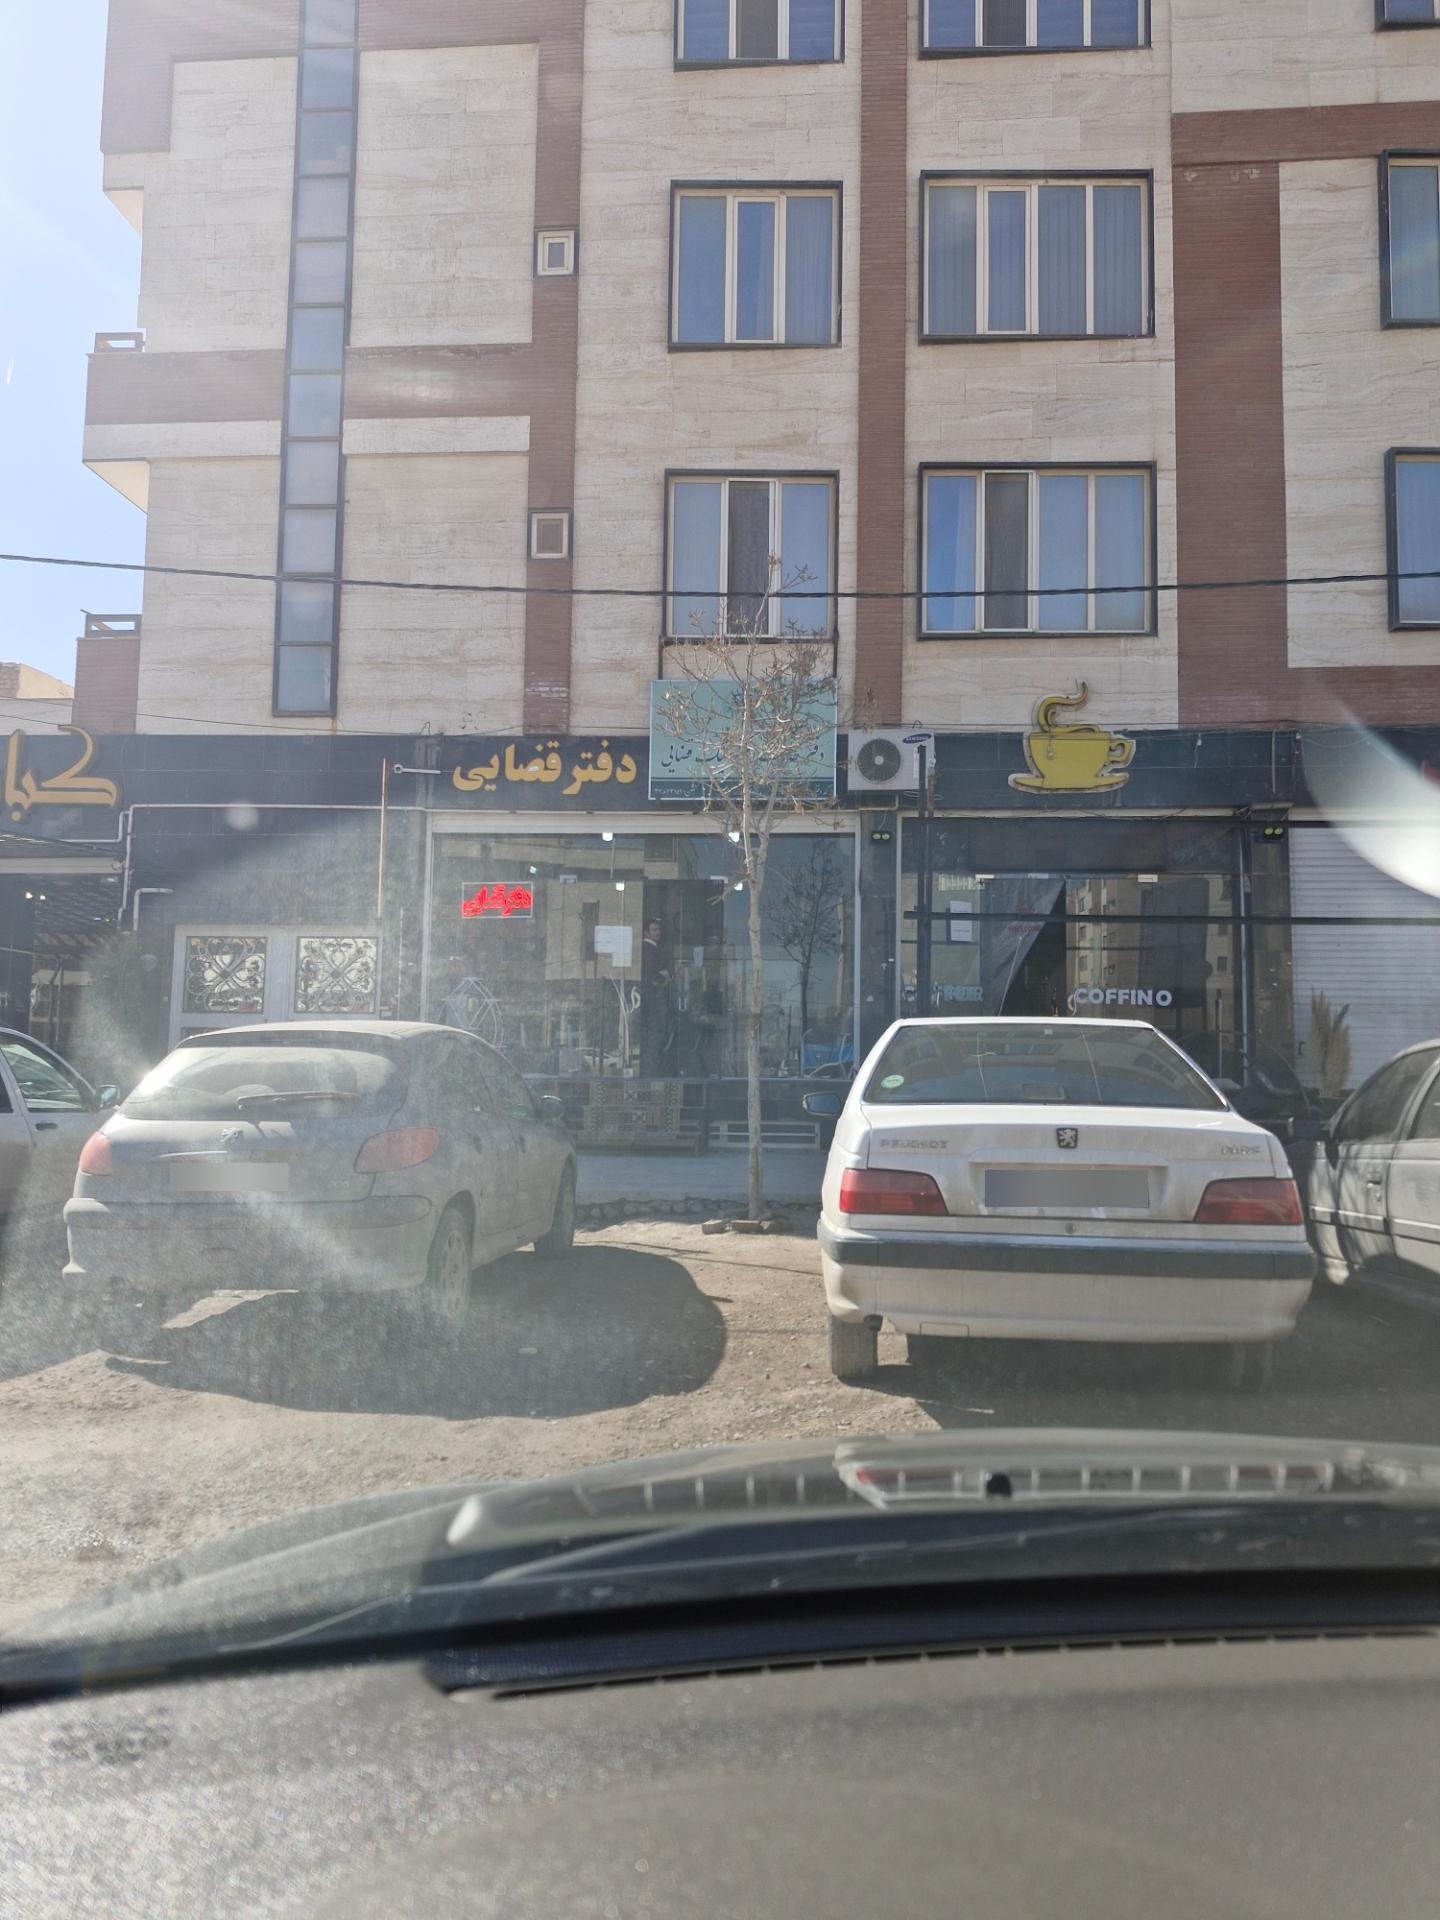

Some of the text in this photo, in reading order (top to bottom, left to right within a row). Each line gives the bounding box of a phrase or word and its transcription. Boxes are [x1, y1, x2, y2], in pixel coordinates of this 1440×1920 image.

[452, 740, 562, 791] قضایی
[562, 739, 637, 795] دفتر
[1075, 988, 1172, 1007] COFFINO
